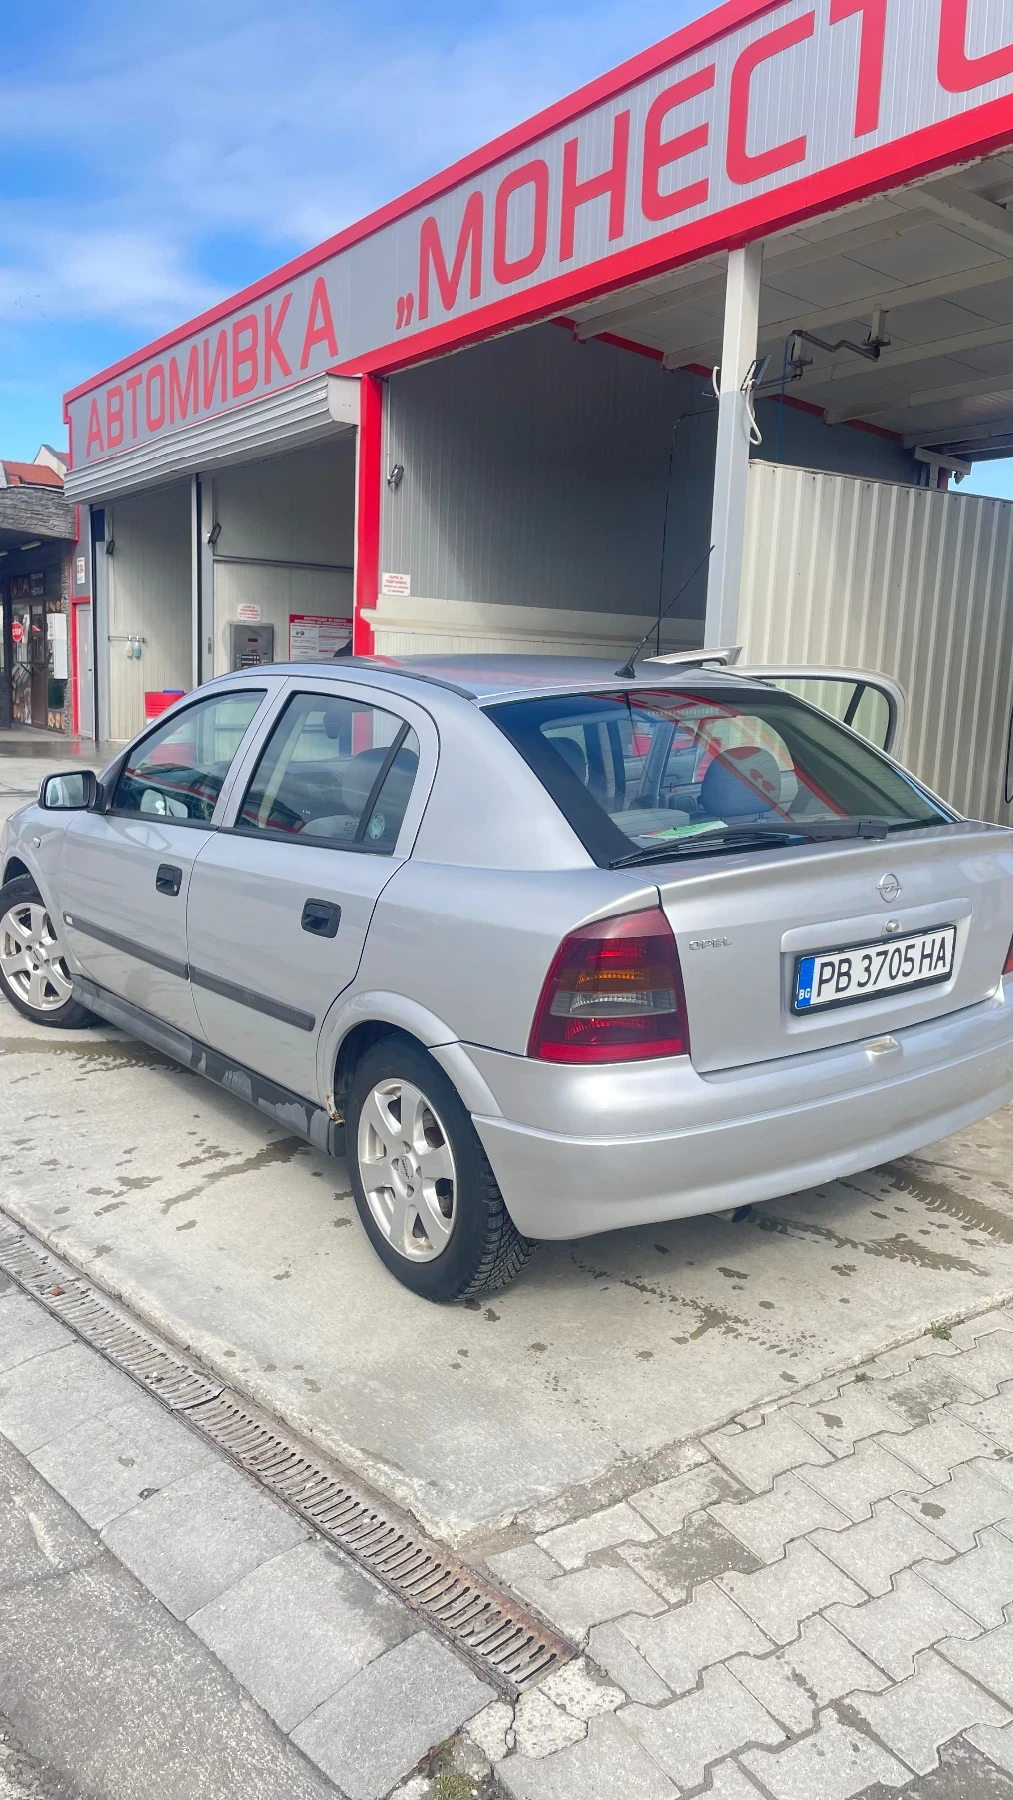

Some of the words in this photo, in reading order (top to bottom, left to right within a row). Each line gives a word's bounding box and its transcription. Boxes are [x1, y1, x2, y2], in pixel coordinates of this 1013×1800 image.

[86, 276, 339, 457] АВТОМИВКА
[689, 936, 732, 951] OPEL
[857, 944, 916, 988] 3705
[799, 989, 811, 1000] BG
